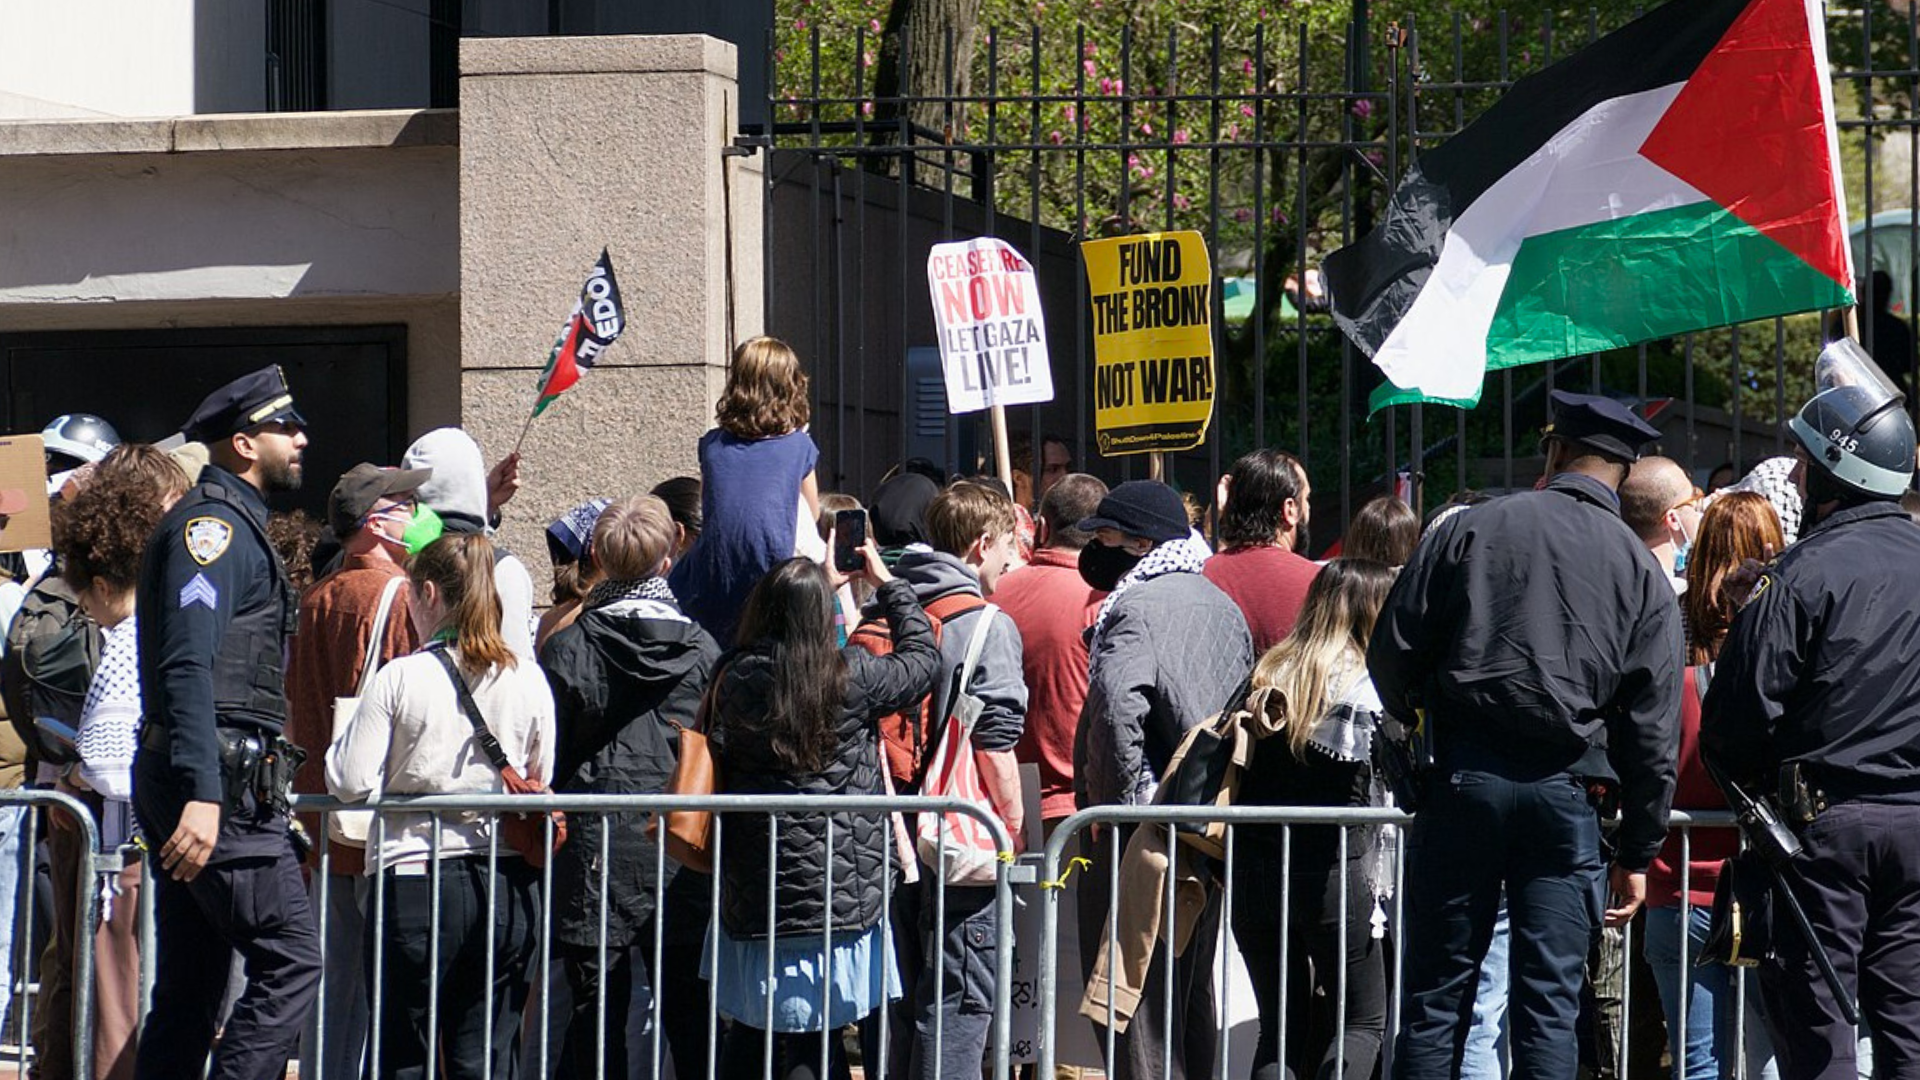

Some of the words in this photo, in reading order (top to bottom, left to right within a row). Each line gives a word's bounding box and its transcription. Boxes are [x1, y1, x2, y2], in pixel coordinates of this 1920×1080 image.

[1119, 239, 1181, 287] FUND
[941, 274, 1025, 324] NOW
[1094, 293, 1128, 335] THE
[1132, 285, 1208, 330] BRONX
[947, 326, 979, 352] LET
[983, 318, 1041, 348] GAZA
[960, 347, 1032, 391] LIVE!
[1098, 361, 1136, 409] NOT
[1141, 356, 1212, 404] WAR!
[1829, 428, 1859, 453] 945
